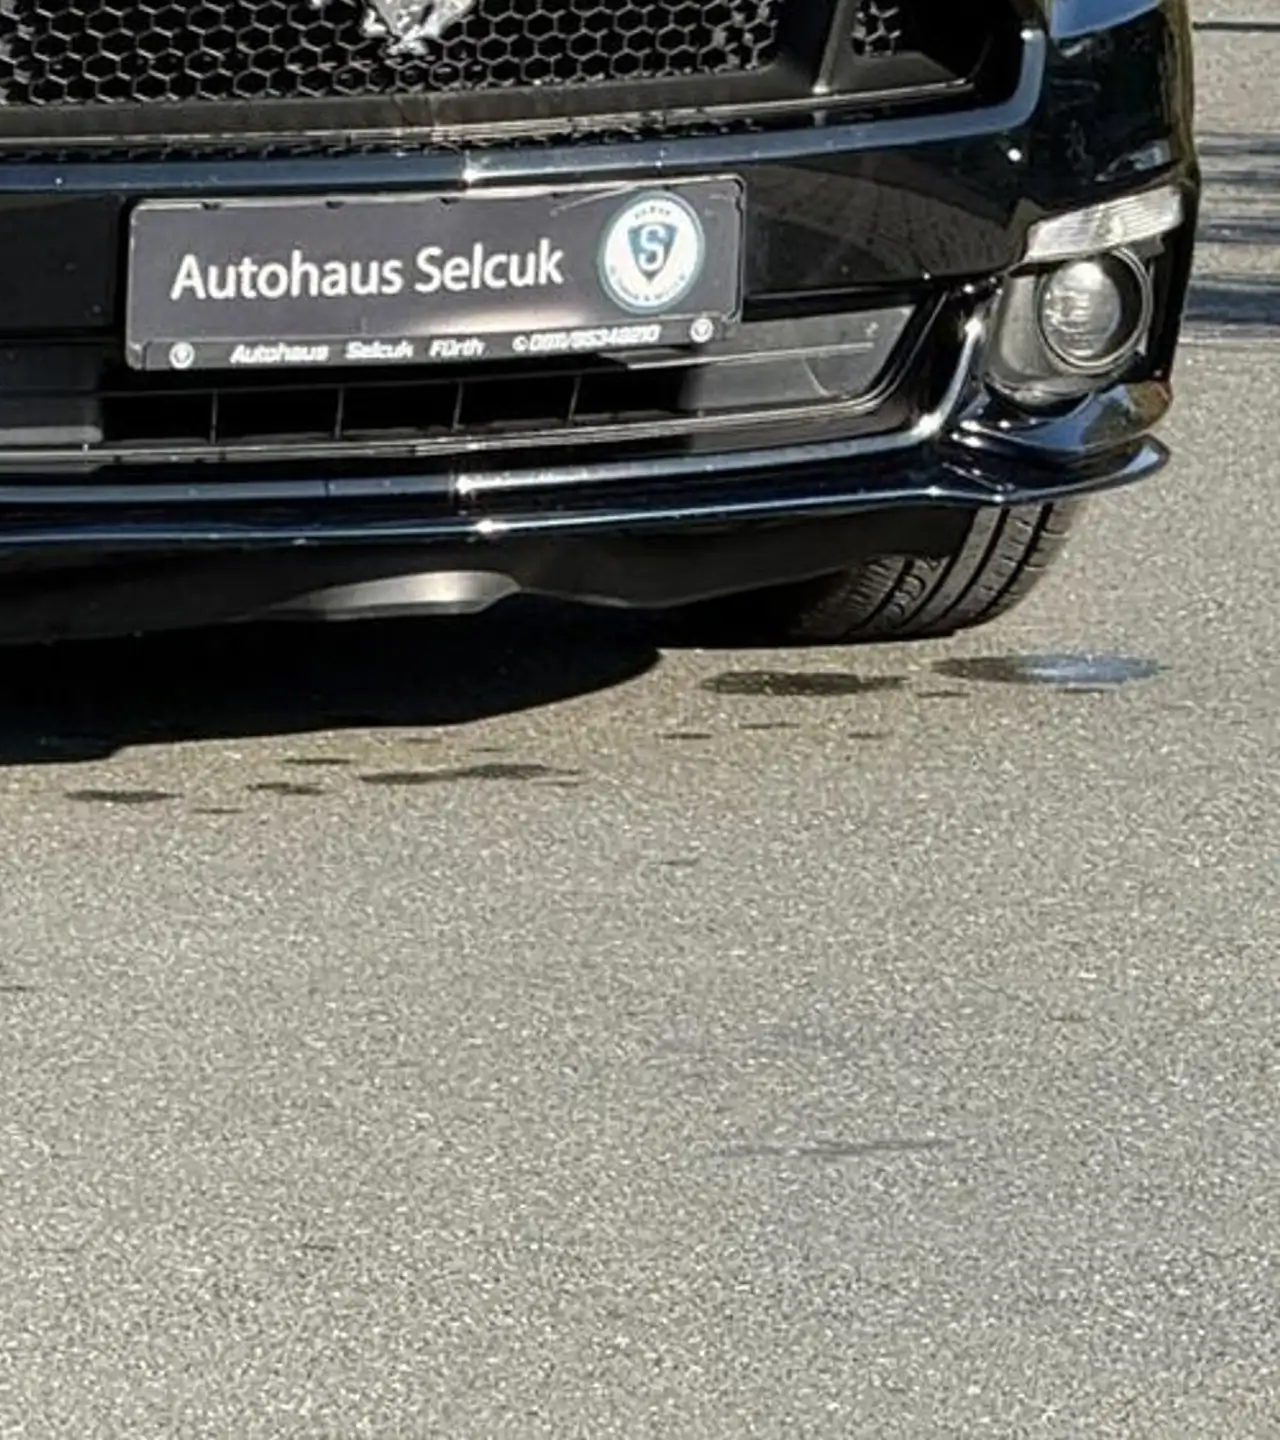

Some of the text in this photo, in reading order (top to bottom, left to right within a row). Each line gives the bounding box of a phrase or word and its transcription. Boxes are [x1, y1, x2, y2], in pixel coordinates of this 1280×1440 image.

[171, 249, 403, 301] Autohaus
[414, 237, 564, 293] Selcuk
[230, 342, 330, 364] Autohaus
[344, 339, 414, 360] Selcuk
[429, 331, 485, 357] Fürth
